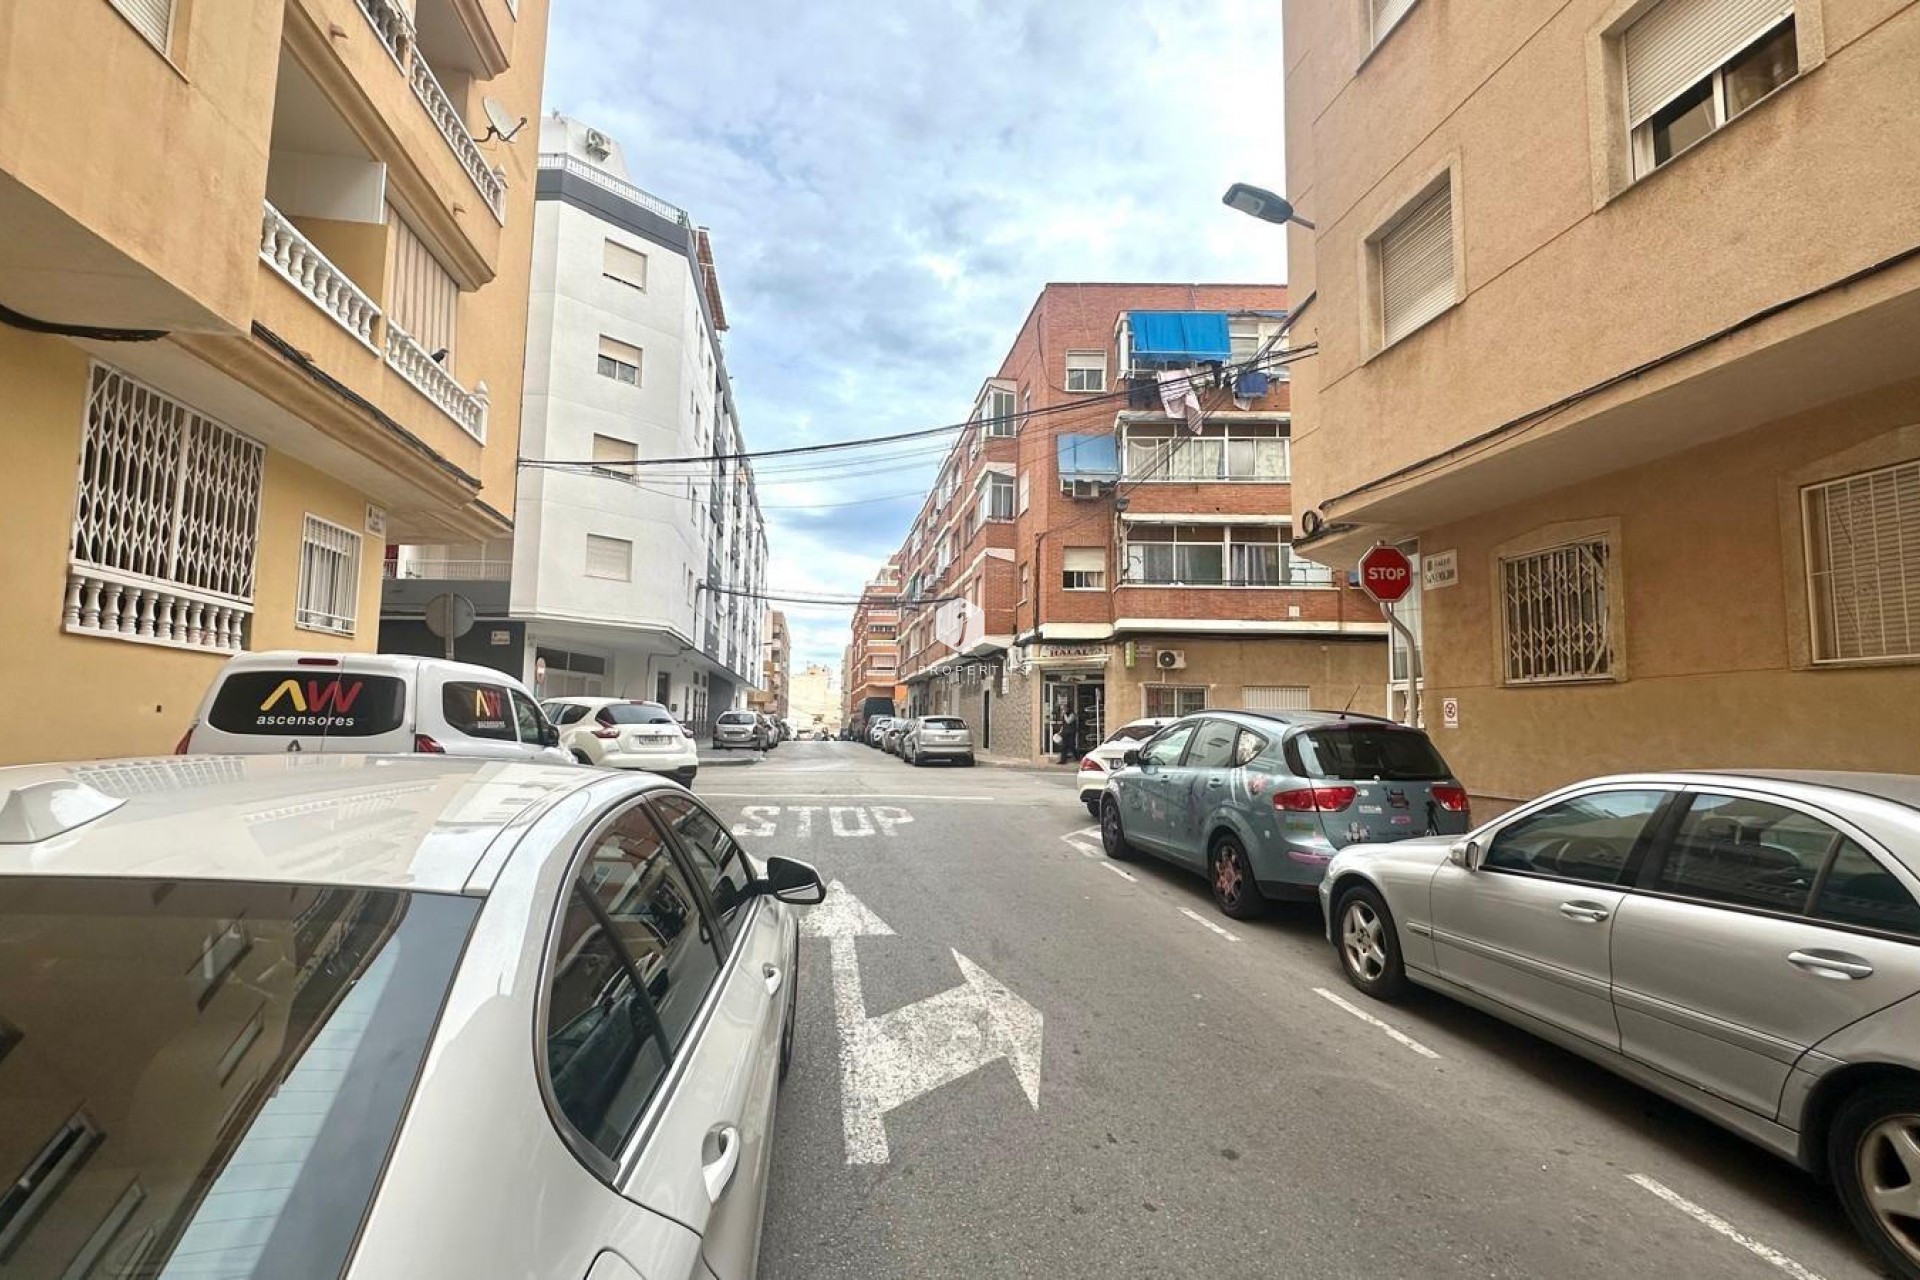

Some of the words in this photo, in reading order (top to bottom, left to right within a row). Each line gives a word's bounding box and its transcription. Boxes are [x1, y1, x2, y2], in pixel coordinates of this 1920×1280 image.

[1368, 567, 1406, 580] STOP
[256, 715, 354, 726] ascensores
[731, 806, 915, 837] STOP
